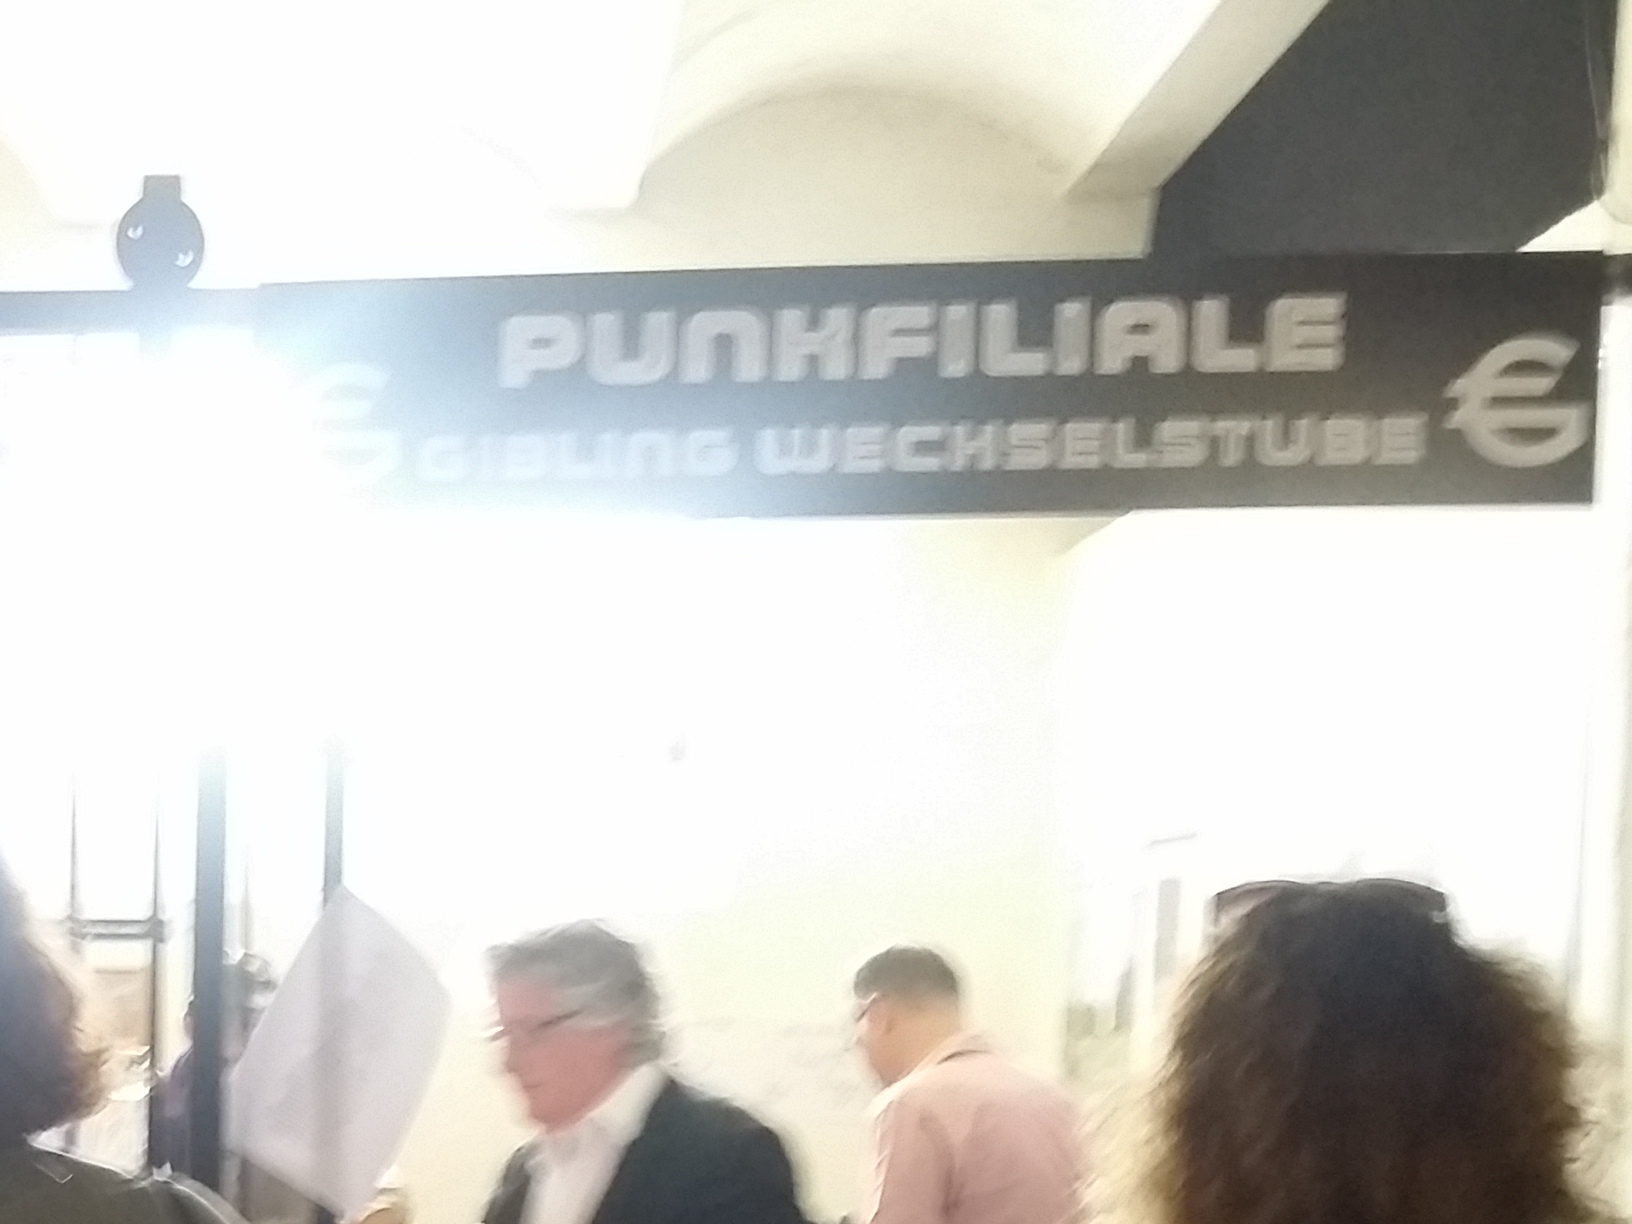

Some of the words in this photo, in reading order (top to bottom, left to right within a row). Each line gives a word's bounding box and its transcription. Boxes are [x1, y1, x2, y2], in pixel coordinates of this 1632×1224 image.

[499, 292, 1348, 388] PUNKFILIALE
[418, 428, 740, 483] GIBLING
[754, 411, 1429, 475] WECHSELSTUBE
